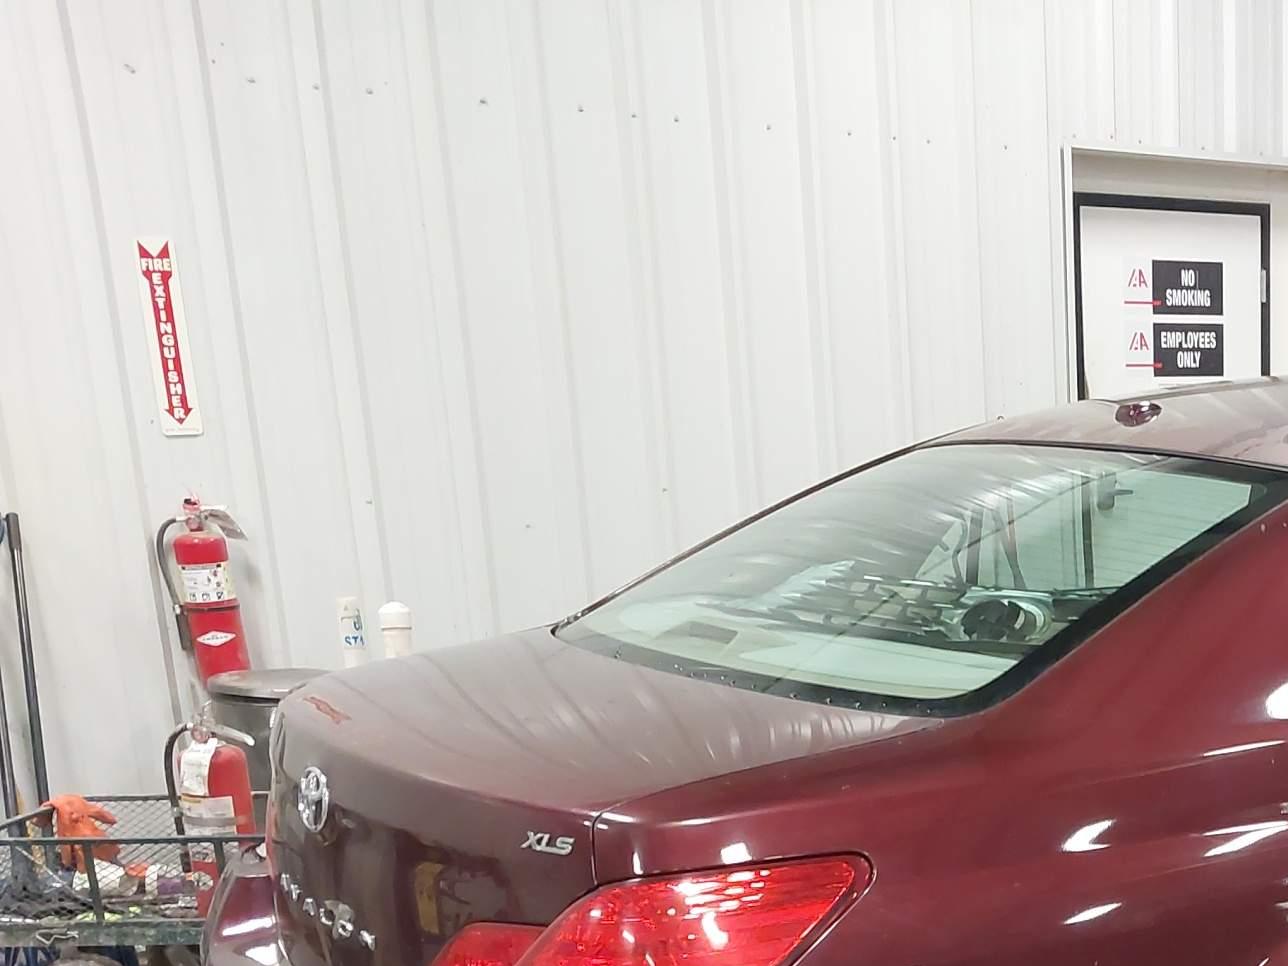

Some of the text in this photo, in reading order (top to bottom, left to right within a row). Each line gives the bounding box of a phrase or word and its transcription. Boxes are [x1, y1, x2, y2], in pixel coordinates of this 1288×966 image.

[140, 257, 172, 272] FIRE
[1181, 269, 1195, 287] NO
[1165, 289, 1211, 307] SMOKING
[152, 271, 186, 420] EXTINGUISHER
[1160, 331, 1217, 349] EMPLOYEES
[1177, 351, 1201, 368] ONLY
[519, 830, 576, 856] XLS
